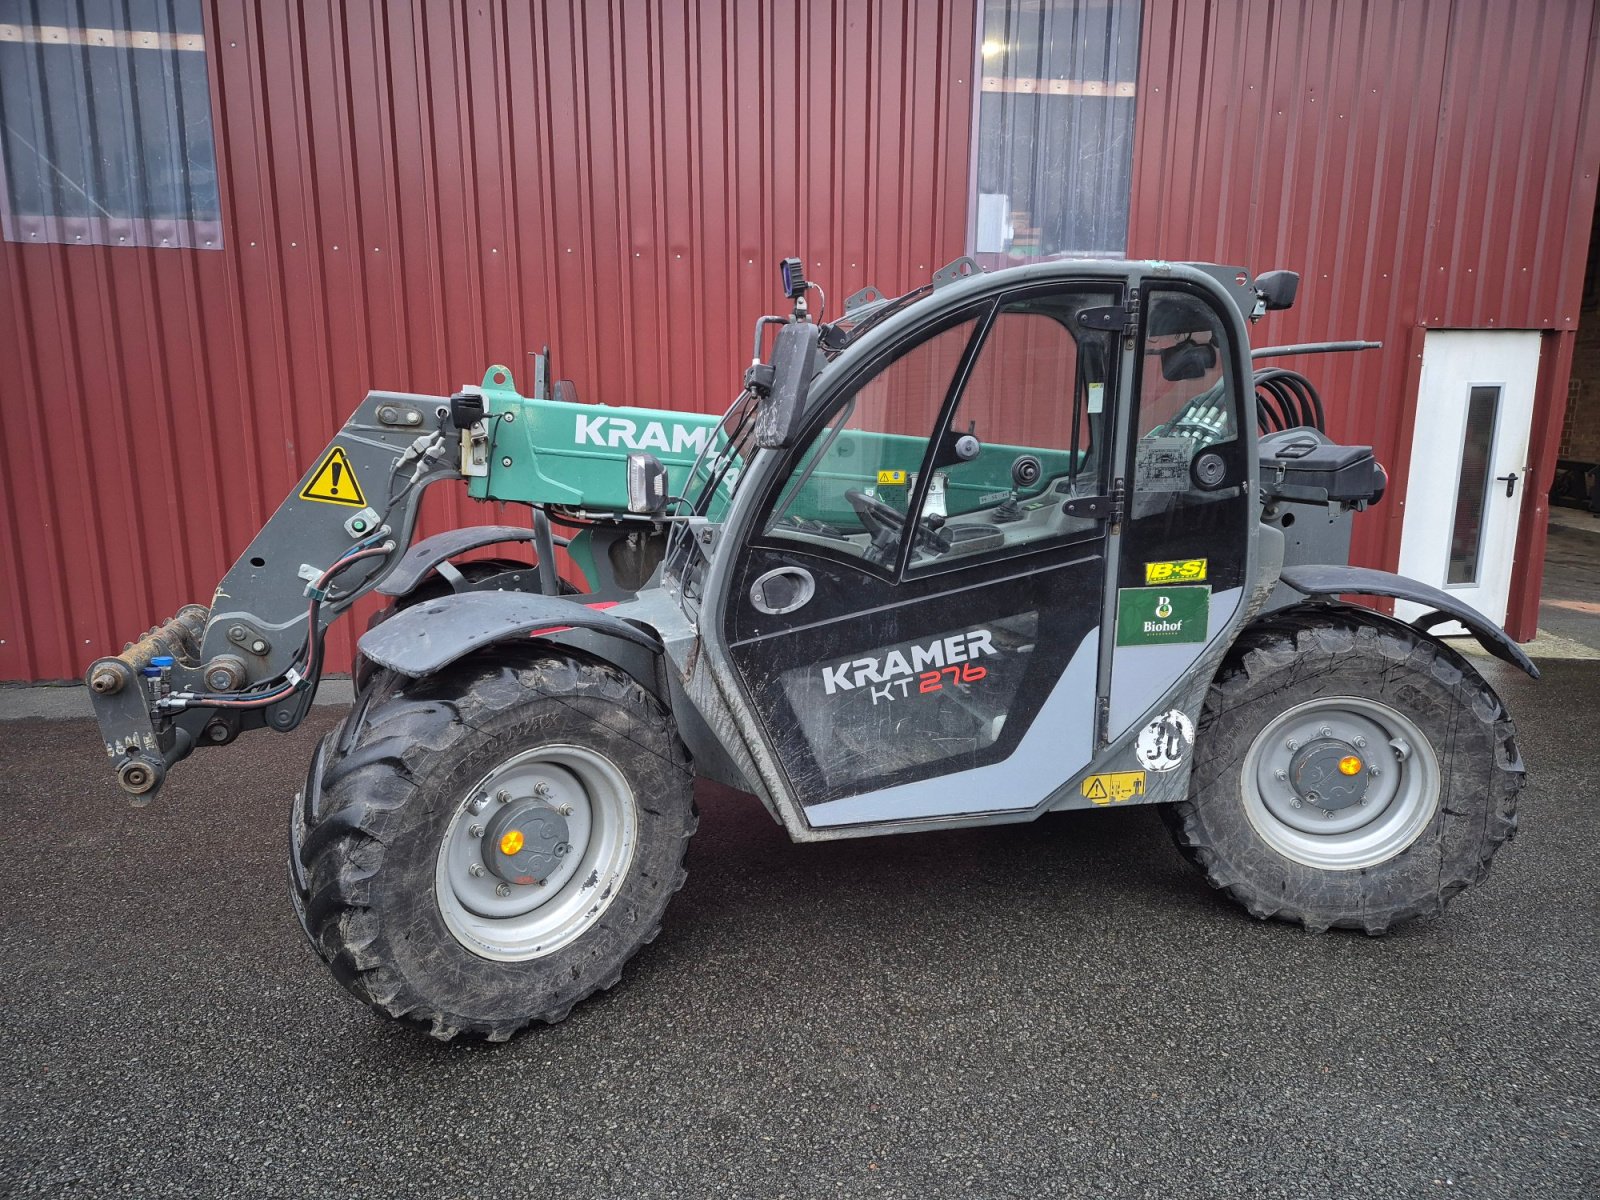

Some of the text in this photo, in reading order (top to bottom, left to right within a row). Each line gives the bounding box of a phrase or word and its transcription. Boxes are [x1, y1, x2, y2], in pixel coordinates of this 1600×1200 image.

[575, 414, 716, 456] KRAM
[1151, 561, 1202, 579] B+S
[1143, 619, 1183, 632] Biohof
[822, 629, 997, 696] KRAMER
[870, 662, 988, 705] KT 276
